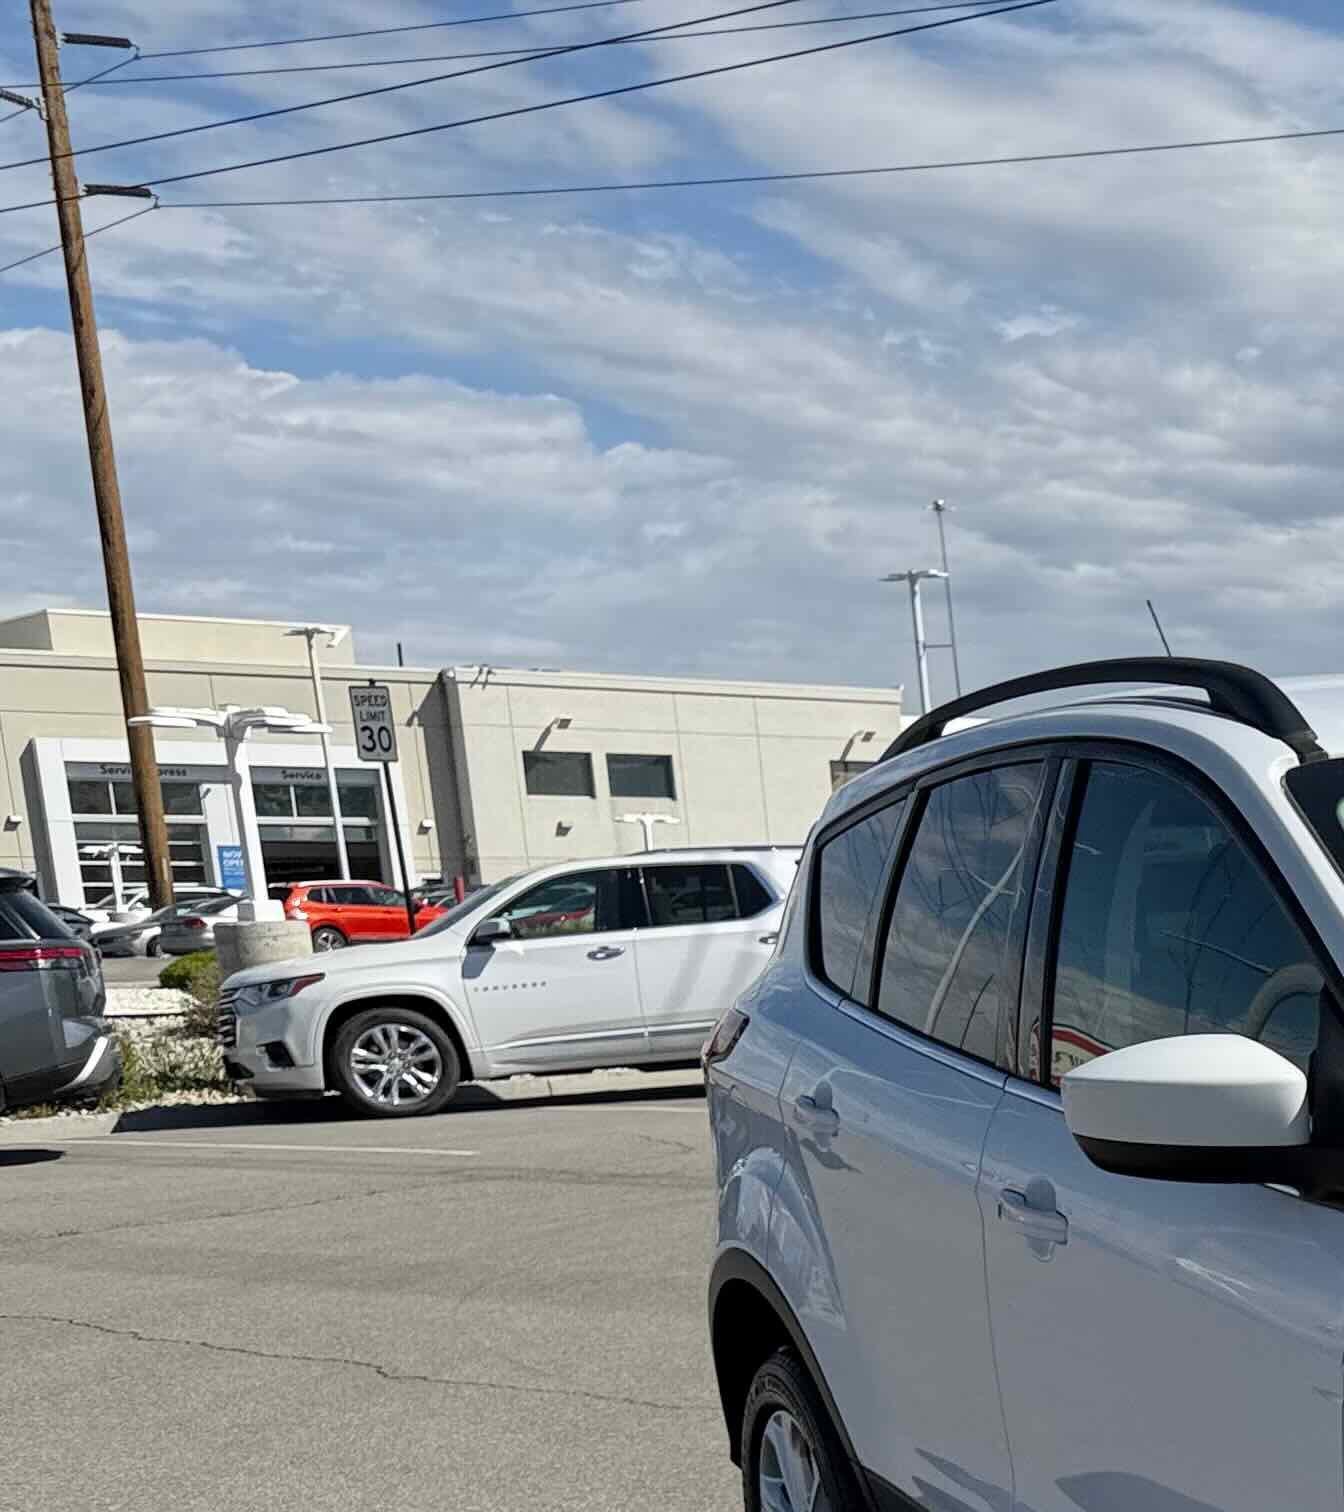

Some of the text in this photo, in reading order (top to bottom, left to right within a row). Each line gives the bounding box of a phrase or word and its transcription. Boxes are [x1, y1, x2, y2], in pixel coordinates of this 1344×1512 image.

[353, 694, 388, 706] SPEED
[360, 711, 386, 722] LIMIT
[361, 725, 392, 752] 30
[281, 769, 322, 780] Service
